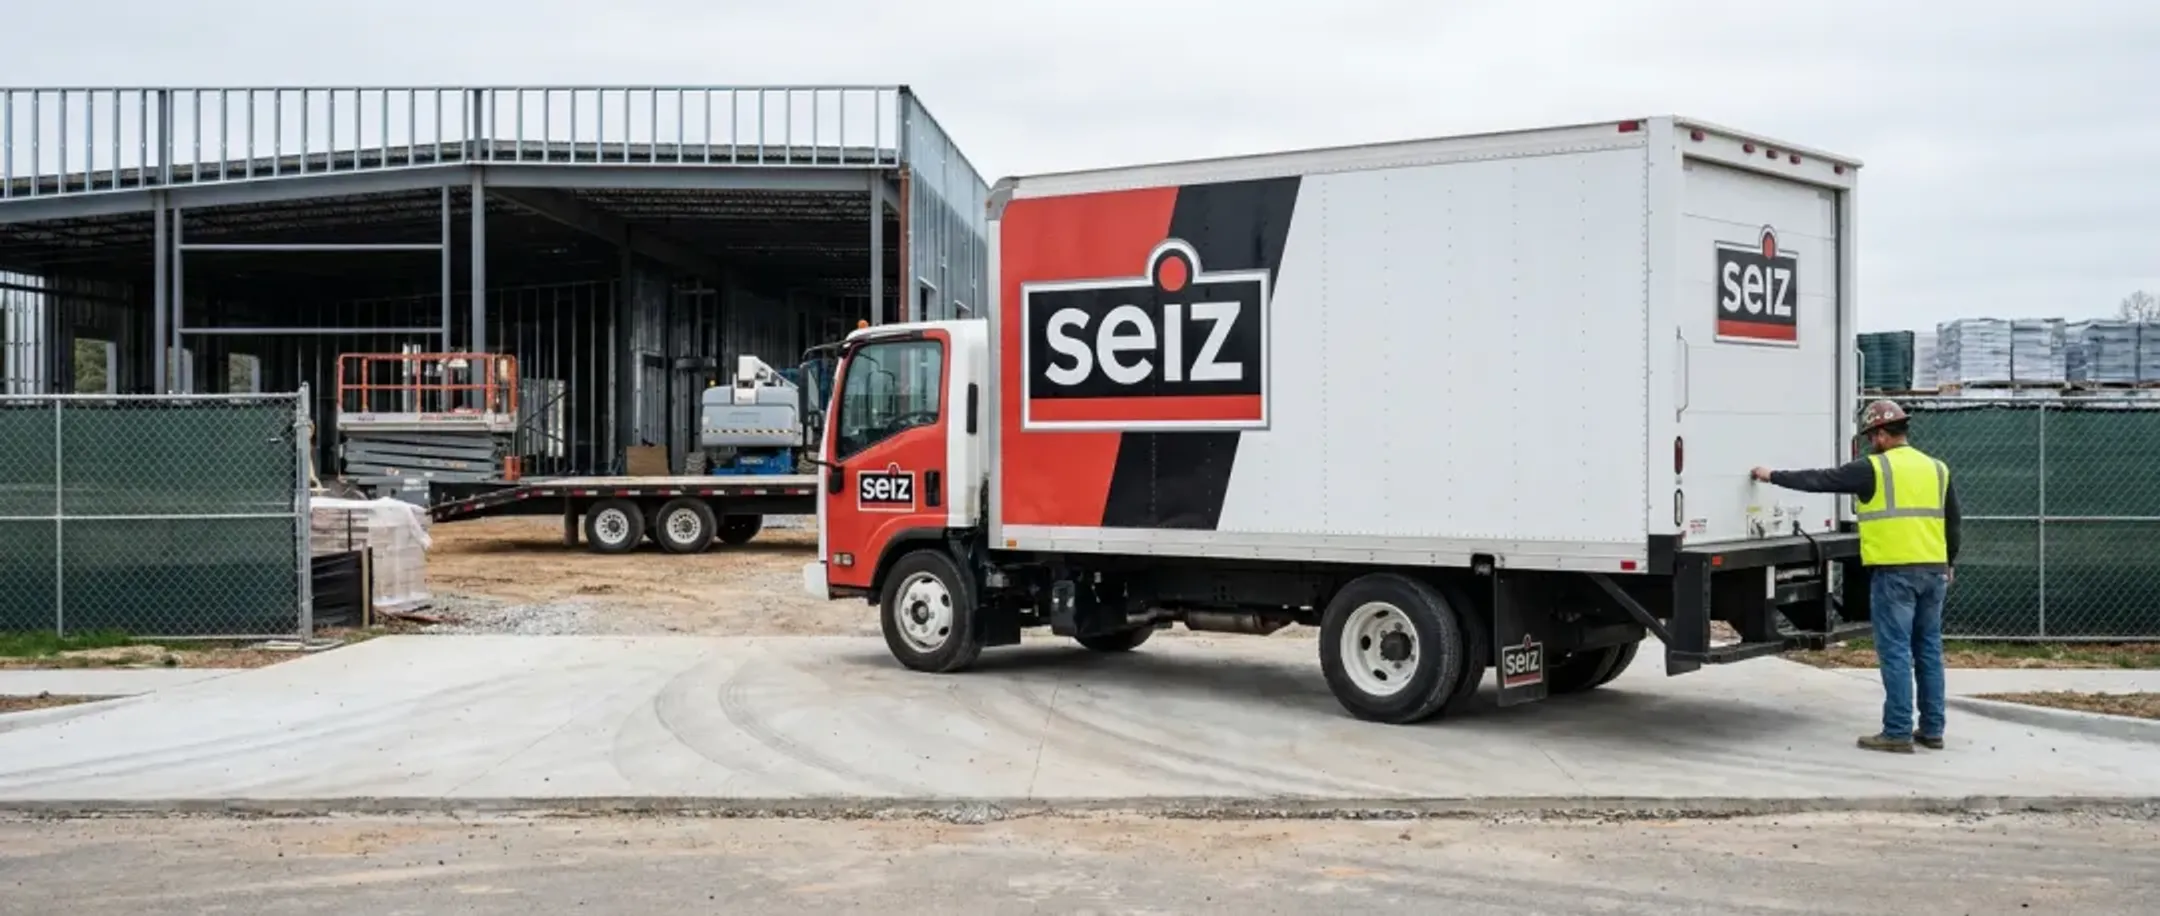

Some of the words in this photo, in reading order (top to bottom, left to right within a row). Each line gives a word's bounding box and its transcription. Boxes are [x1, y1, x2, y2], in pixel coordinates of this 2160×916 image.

[1721, 236, 1792, 317] seiz
[1045, 255, 1244, 386] seiz
[862, 466, 910, 500] seiz
[1505, 640, 1540, 675] seiz
